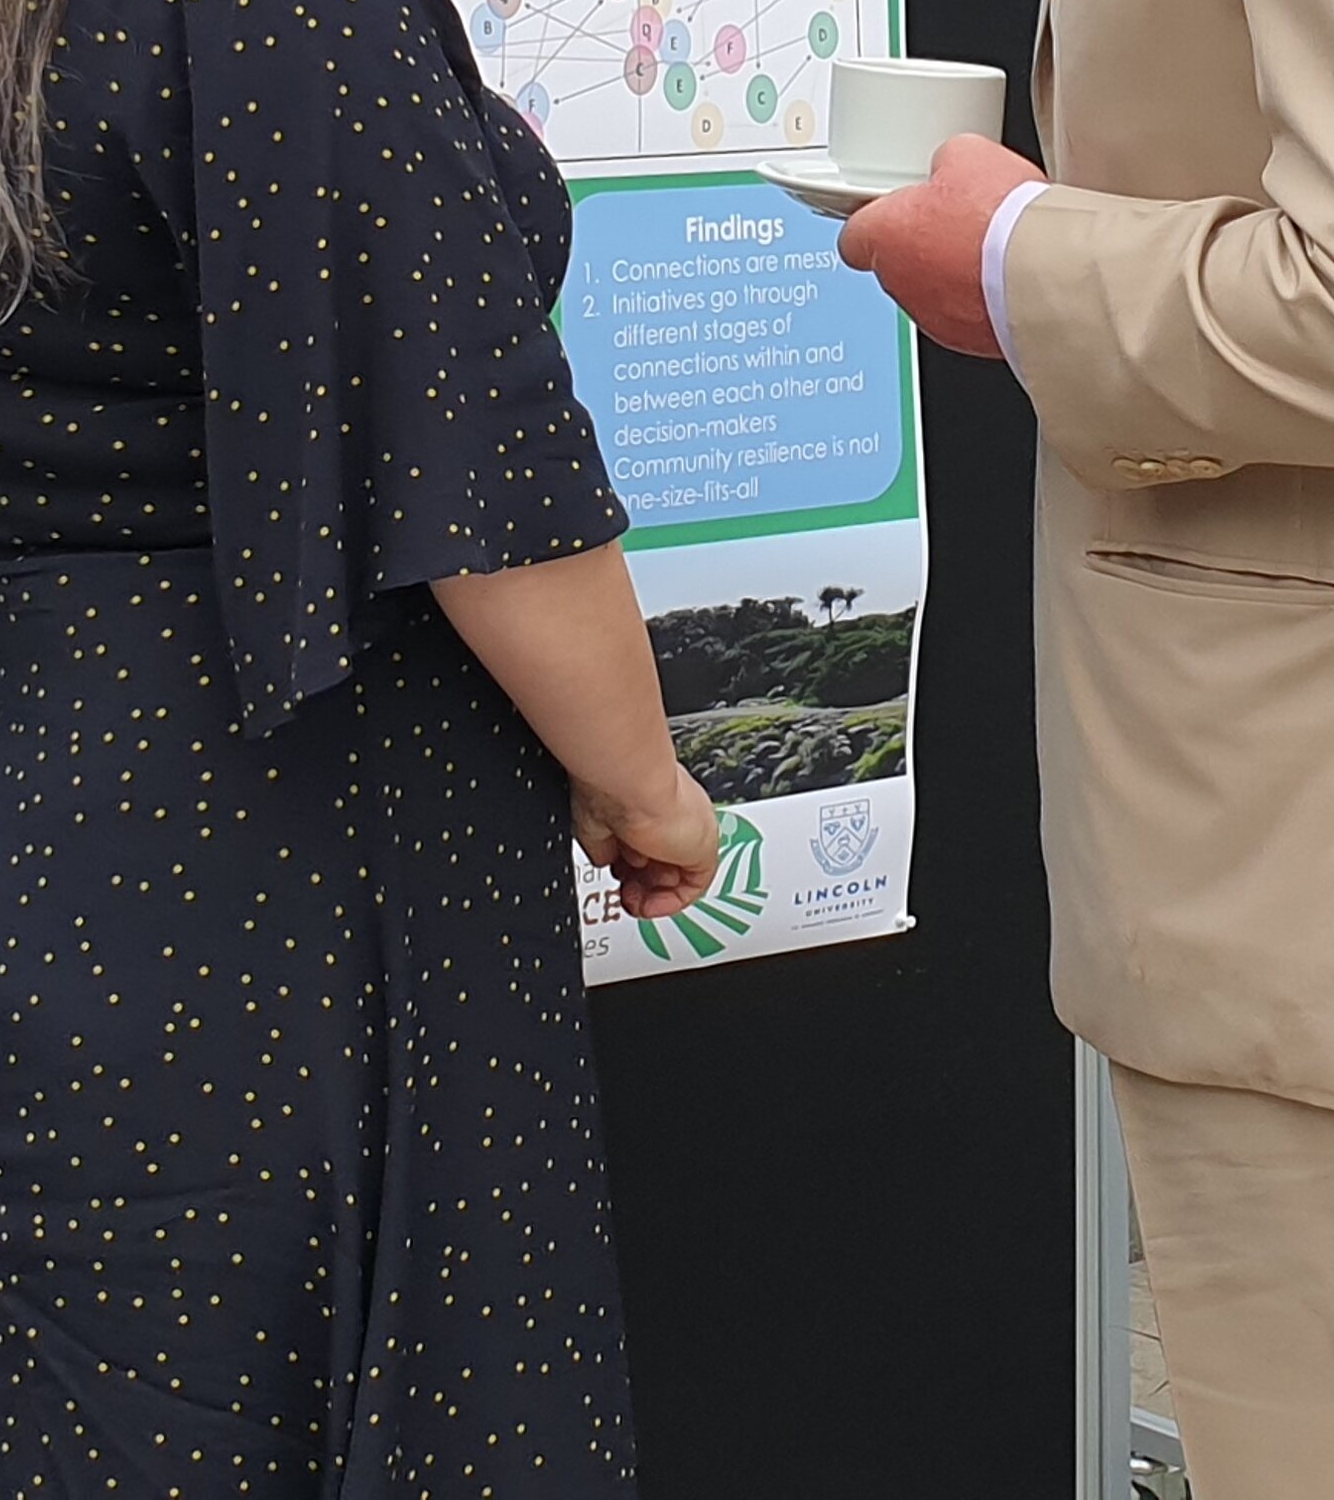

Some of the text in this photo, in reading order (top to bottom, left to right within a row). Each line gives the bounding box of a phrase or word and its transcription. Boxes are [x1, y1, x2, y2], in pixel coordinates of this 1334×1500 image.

[686, 214, 784, 245] Findings
[583, 250, 838, 284] 1. Connections are messy
[582, 279, 818, 318] 2. Initiatives go through
[614, 311, 792, 348] different stages of
[614, 341, 844, 381] connections within and
[615, 370, 864, 414] between each other and
[614, 412, 777, 447] decision-makers
[614, 431, 879, 480] Community resilience is not
[794, 875, 887, 905] LINCOLN
[805, 898, 874, 917] UNIVERSITY
